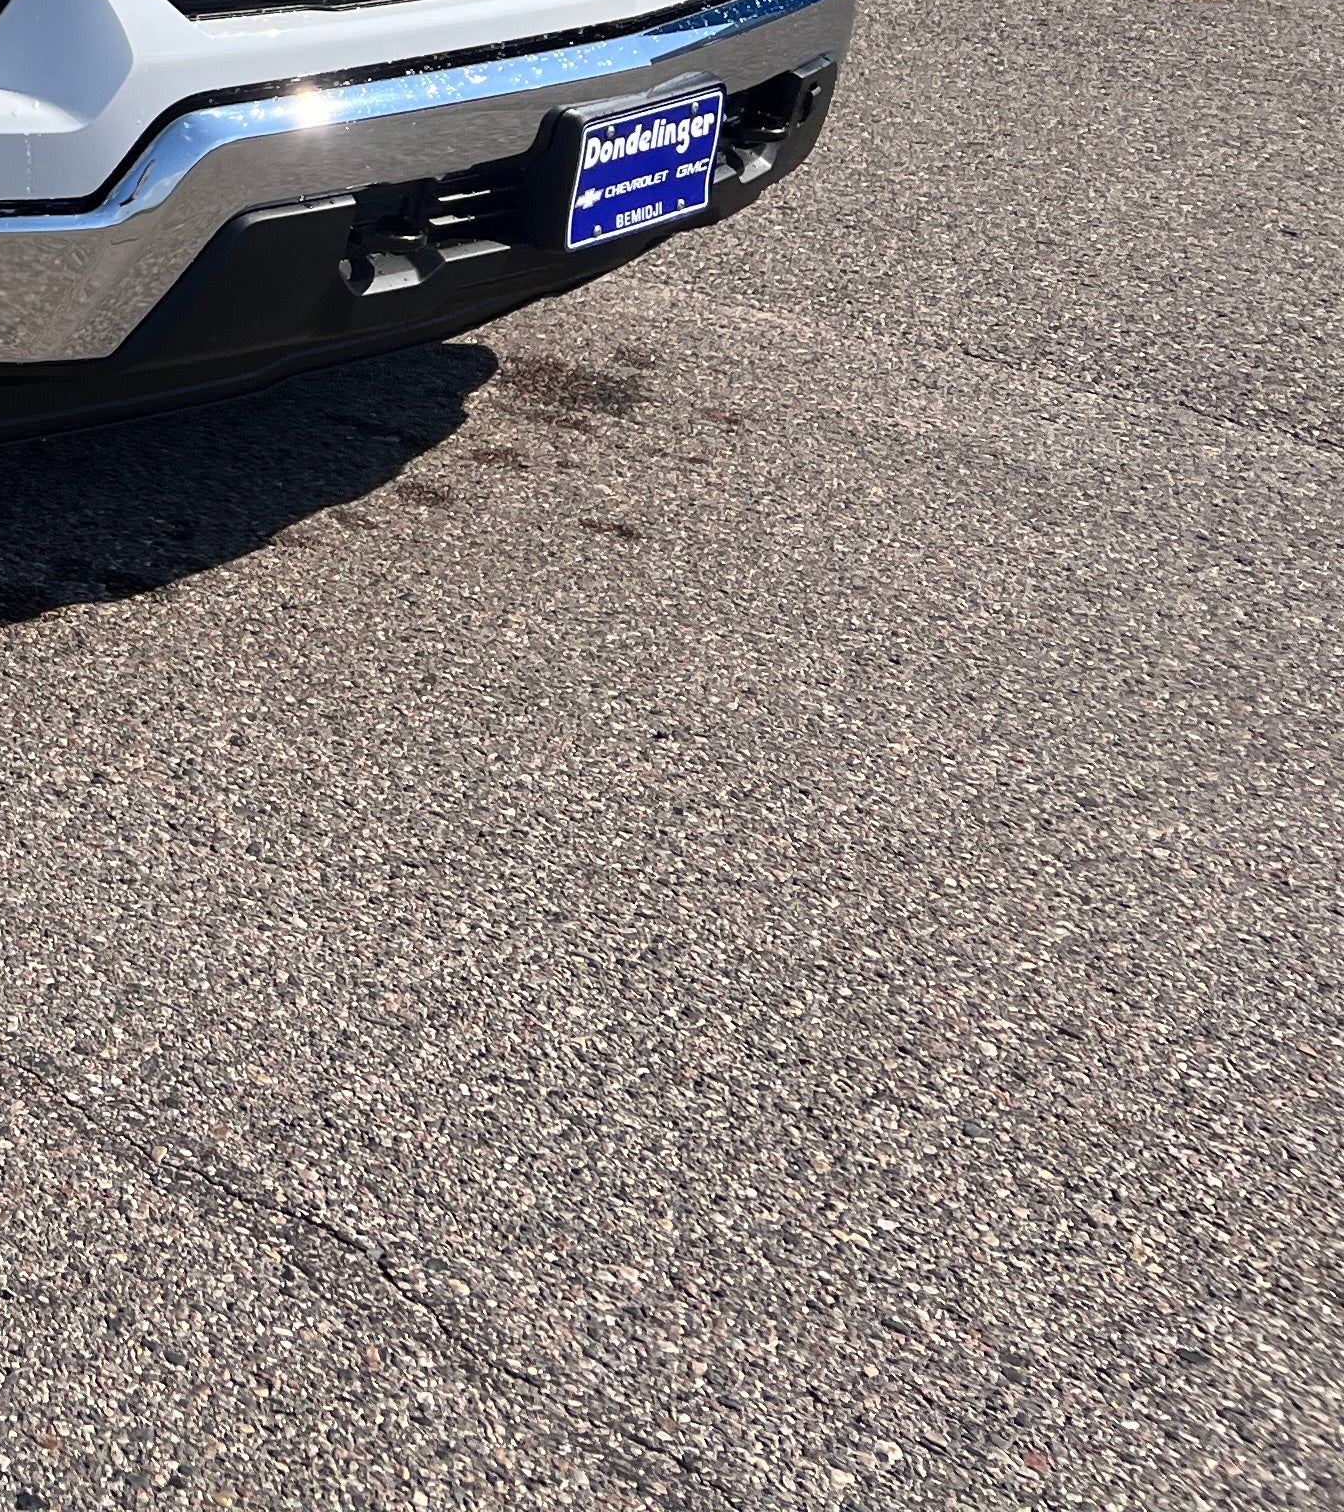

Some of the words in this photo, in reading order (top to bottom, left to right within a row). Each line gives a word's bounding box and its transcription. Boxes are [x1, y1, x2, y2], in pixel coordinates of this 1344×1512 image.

[584, 112, 715, 170] Dondelinger
[604, 170, 669, 199] CHEVROLET
[676, 159, 709, 180] GMC
[616, 201, 663, 229] BEMIDJI
